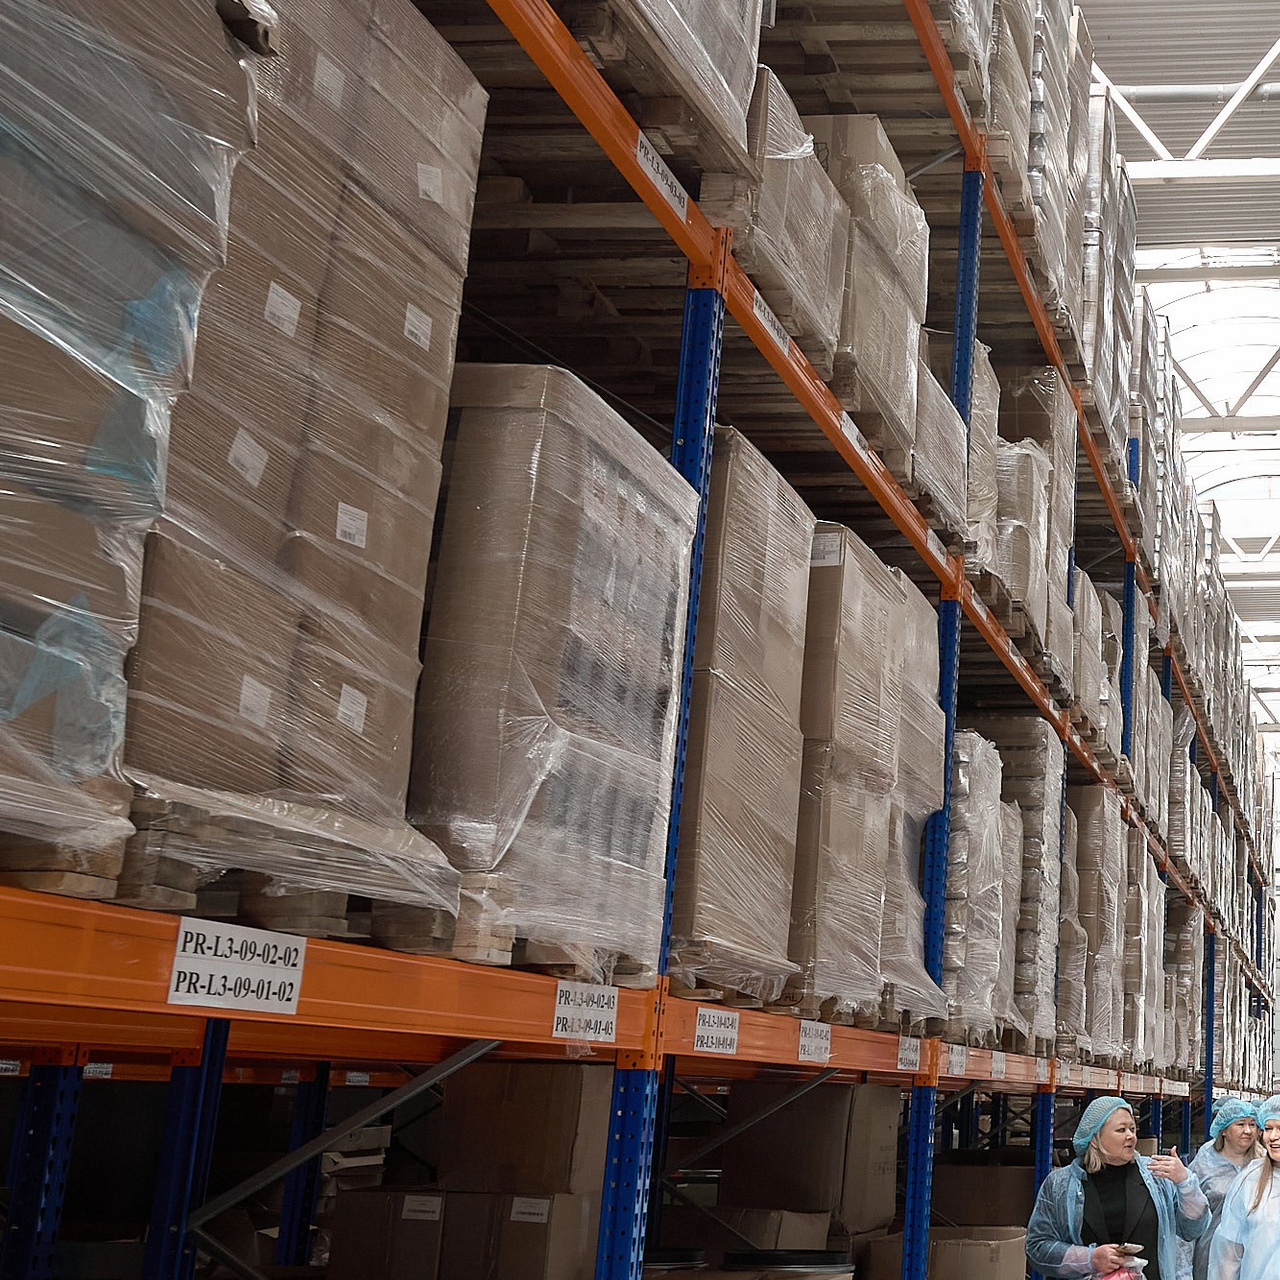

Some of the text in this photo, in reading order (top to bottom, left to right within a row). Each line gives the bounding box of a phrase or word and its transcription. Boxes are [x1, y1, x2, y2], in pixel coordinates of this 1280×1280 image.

[181, 930, 299, 967] PR-L3-09-02-02
[174, 970, 295, 1002] PR-L3-09-01-02
[558, 989, 616, 1010] PR-L3-09-02-03
